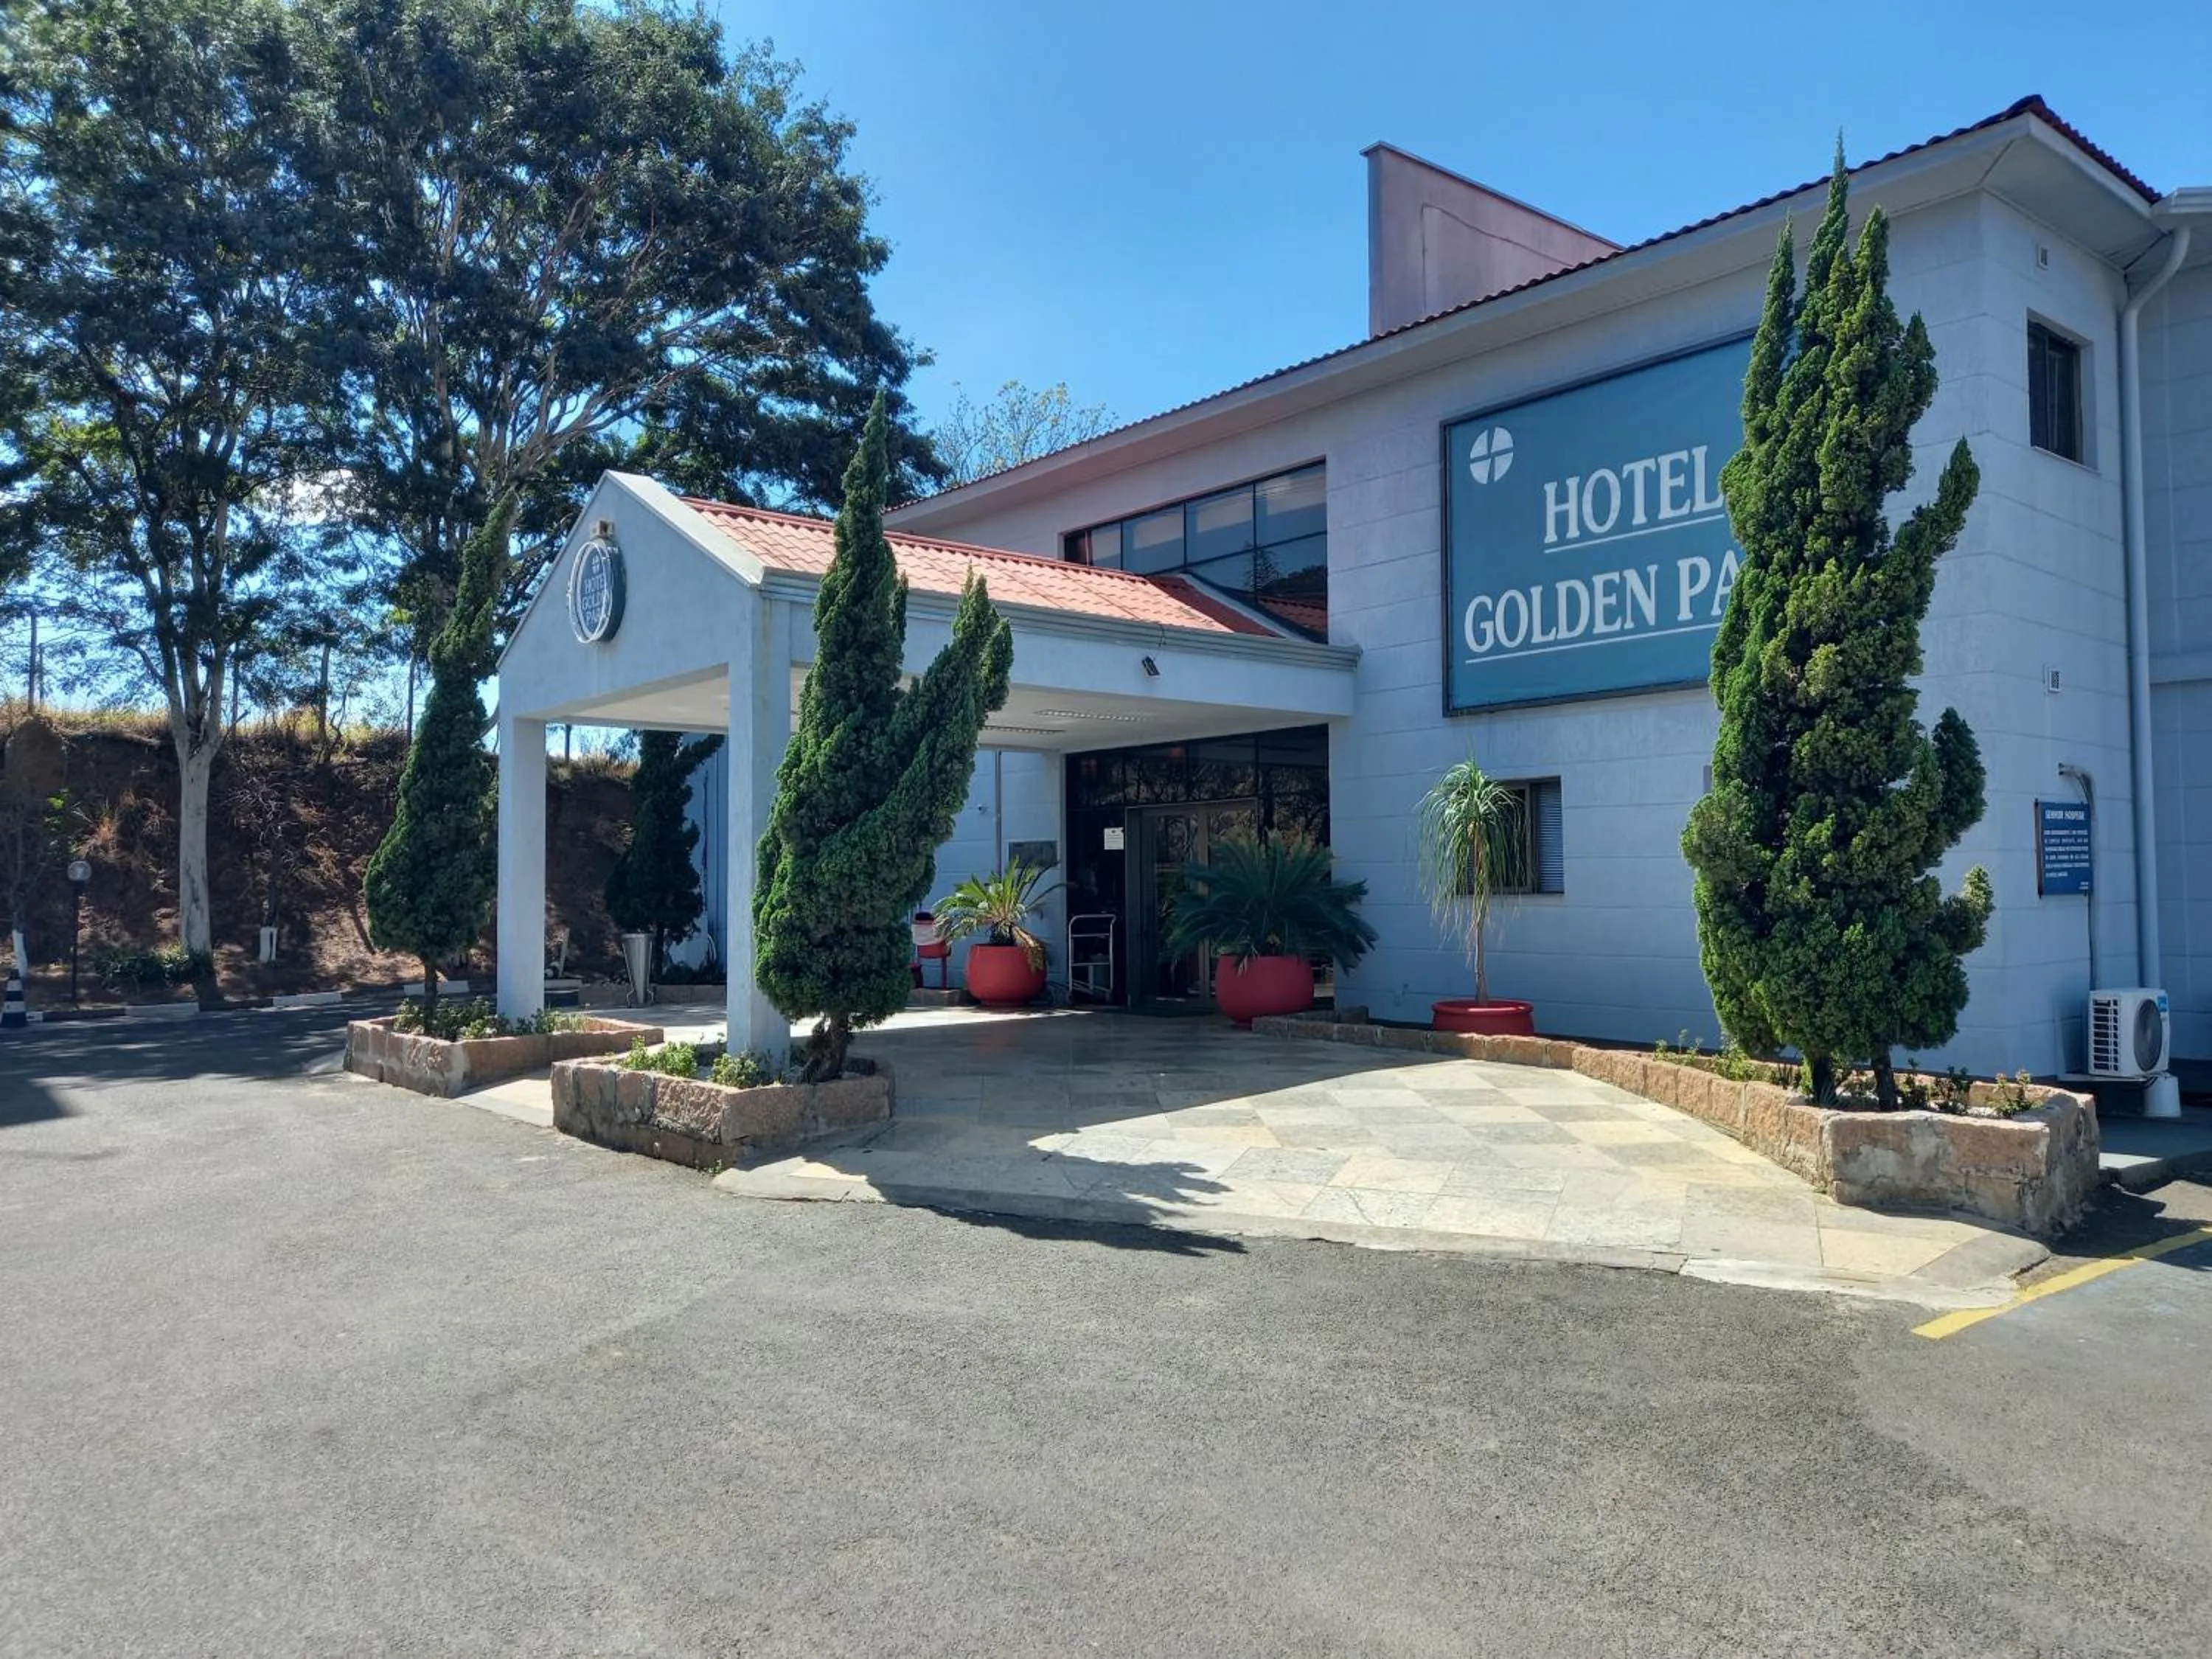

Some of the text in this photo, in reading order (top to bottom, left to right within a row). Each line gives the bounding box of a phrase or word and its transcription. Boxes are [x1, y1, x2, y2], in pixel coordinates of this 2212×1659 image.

[1543, 445, 1725, 543] HOTEL
[1464, 549, 1743, 653] GOLDEN PA
